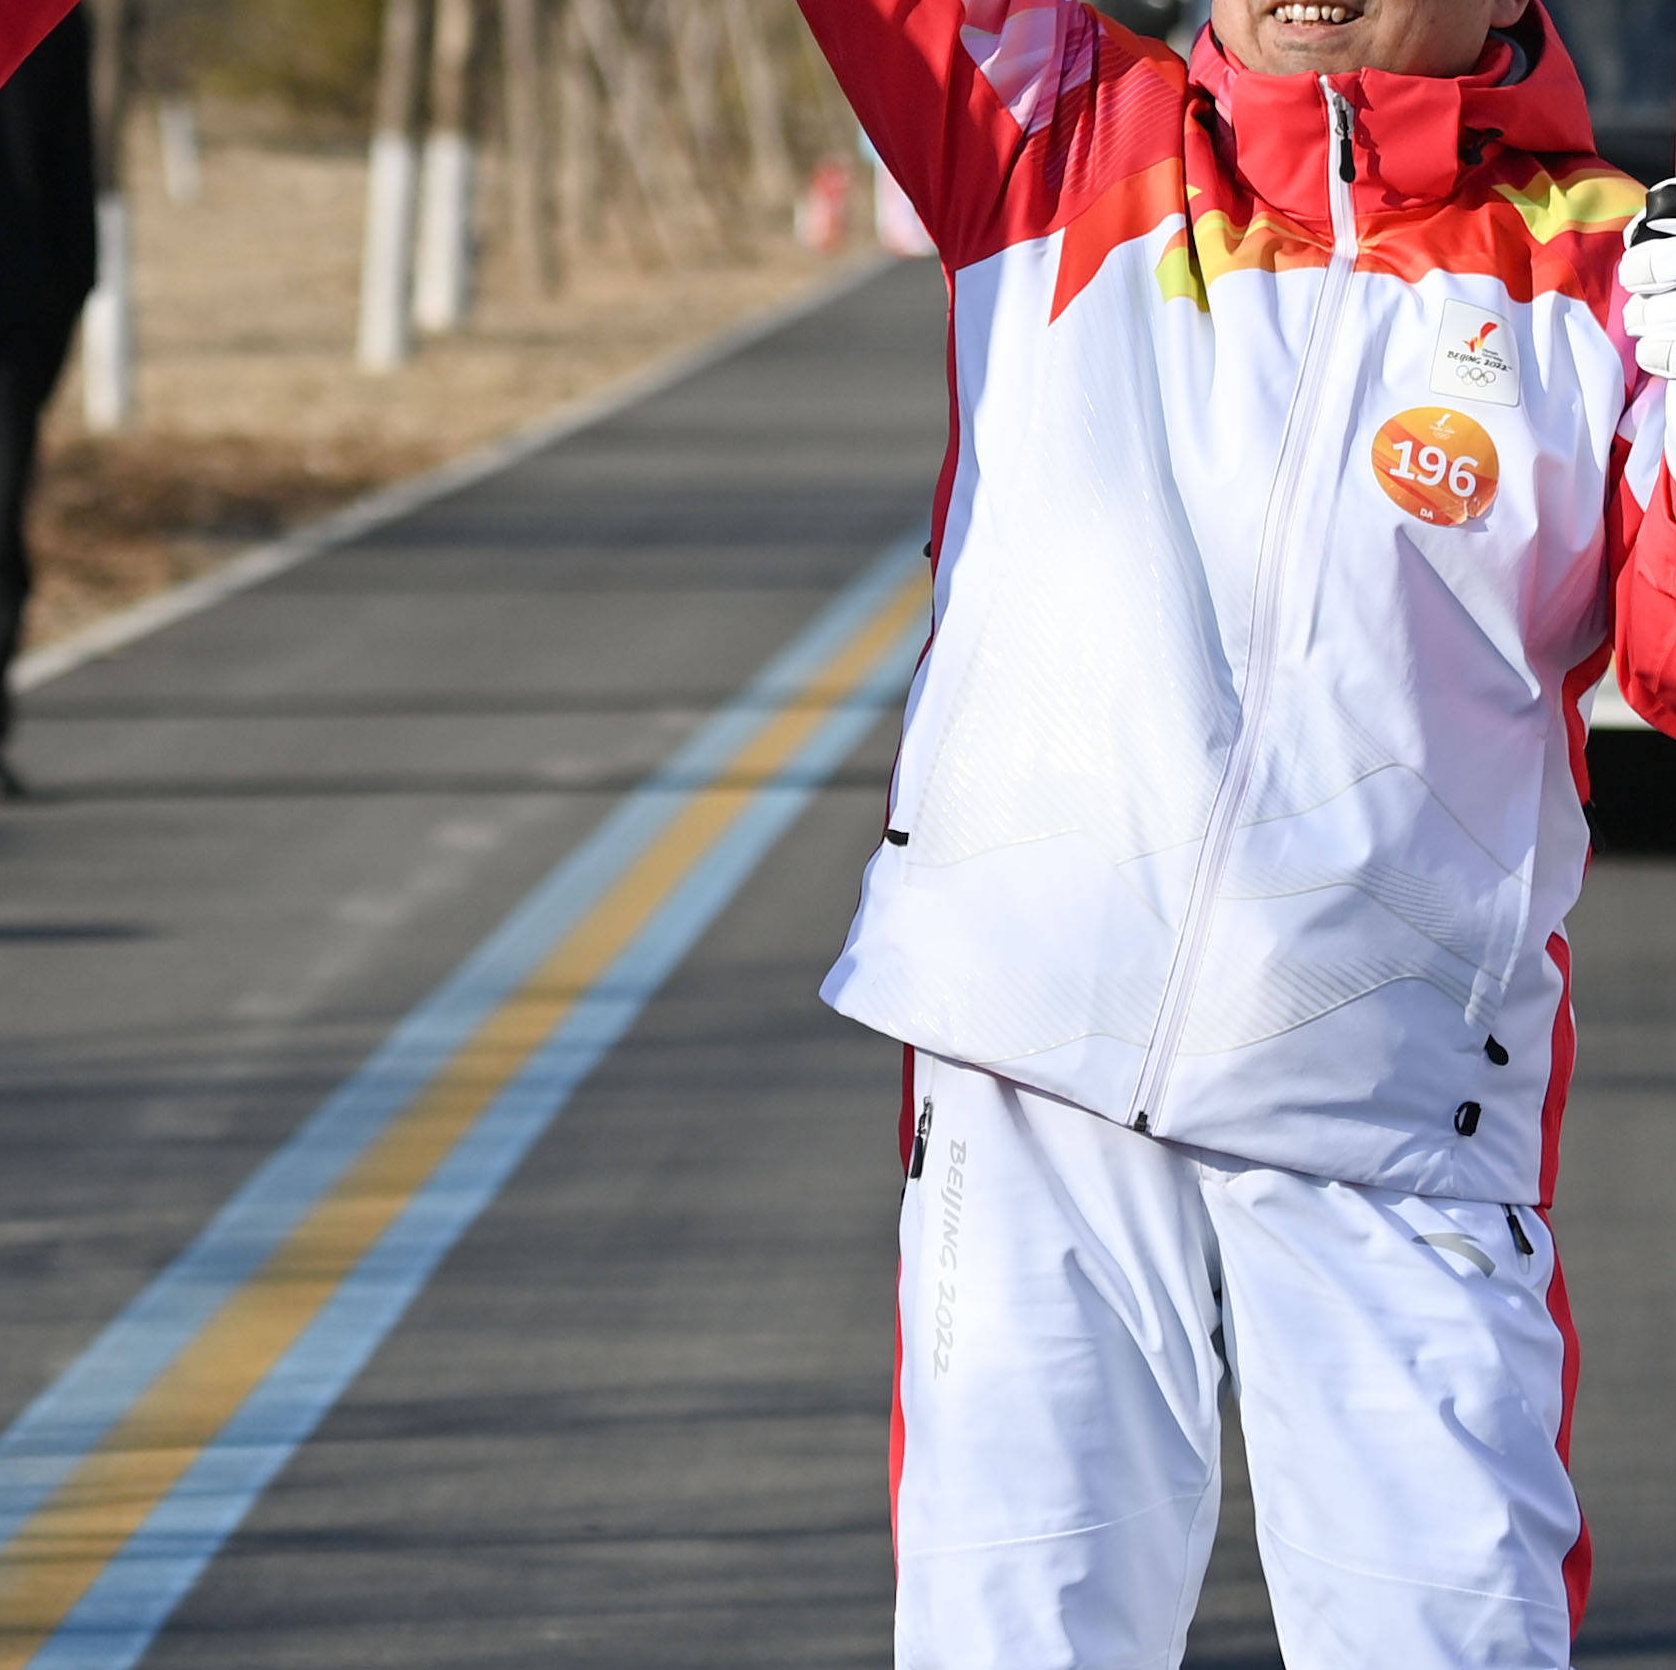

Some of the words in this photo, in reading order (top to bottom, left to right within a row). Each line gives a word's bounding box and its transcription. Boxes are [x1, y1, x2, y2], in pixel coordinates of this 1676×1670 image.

[1447, 350, 1482, 364] BEIJING
[1389, 440, 1479, 498] 196
[1419, 507, 1434, 520] DA
[938, 1138, 967, 1270] BEIJING
[933, 1281, 956, 1380] 2022
